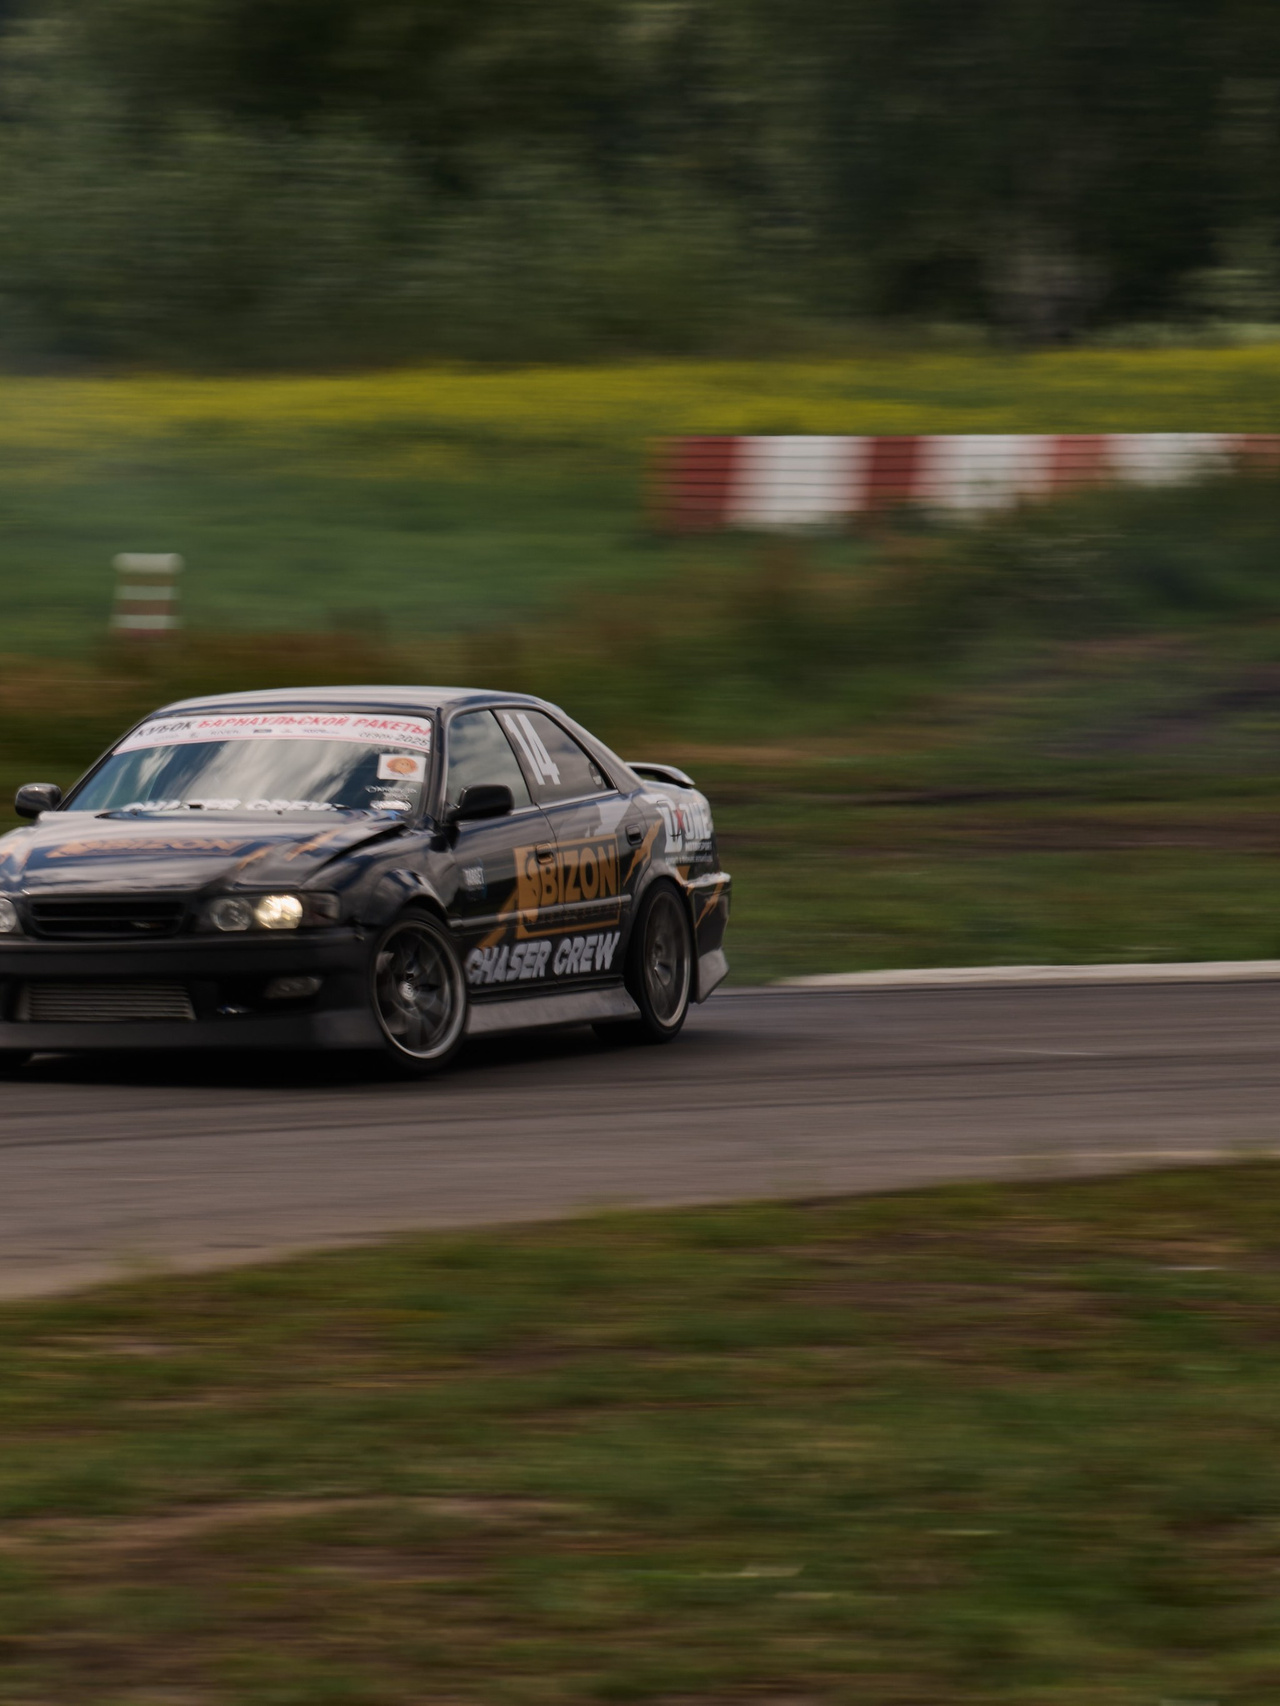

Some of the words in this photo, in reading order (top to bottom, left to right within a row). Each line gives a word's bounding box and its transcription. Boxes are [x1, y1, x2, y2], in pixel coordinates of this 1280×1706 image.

[134, 721, 196, 738] КУБОК
[197, 715, 350, 729] БАРНАУЛЬСКОЙ
[353, 718, 432, 736] РАКЕТЫ
[395, 733, 430, 747] 2025
[503, 713, 561, 785] 14
[540, 844, 617, 906] BIZON
[465, 940, 552, 985] CHASER
[553, 931, 621, 976] CREW
